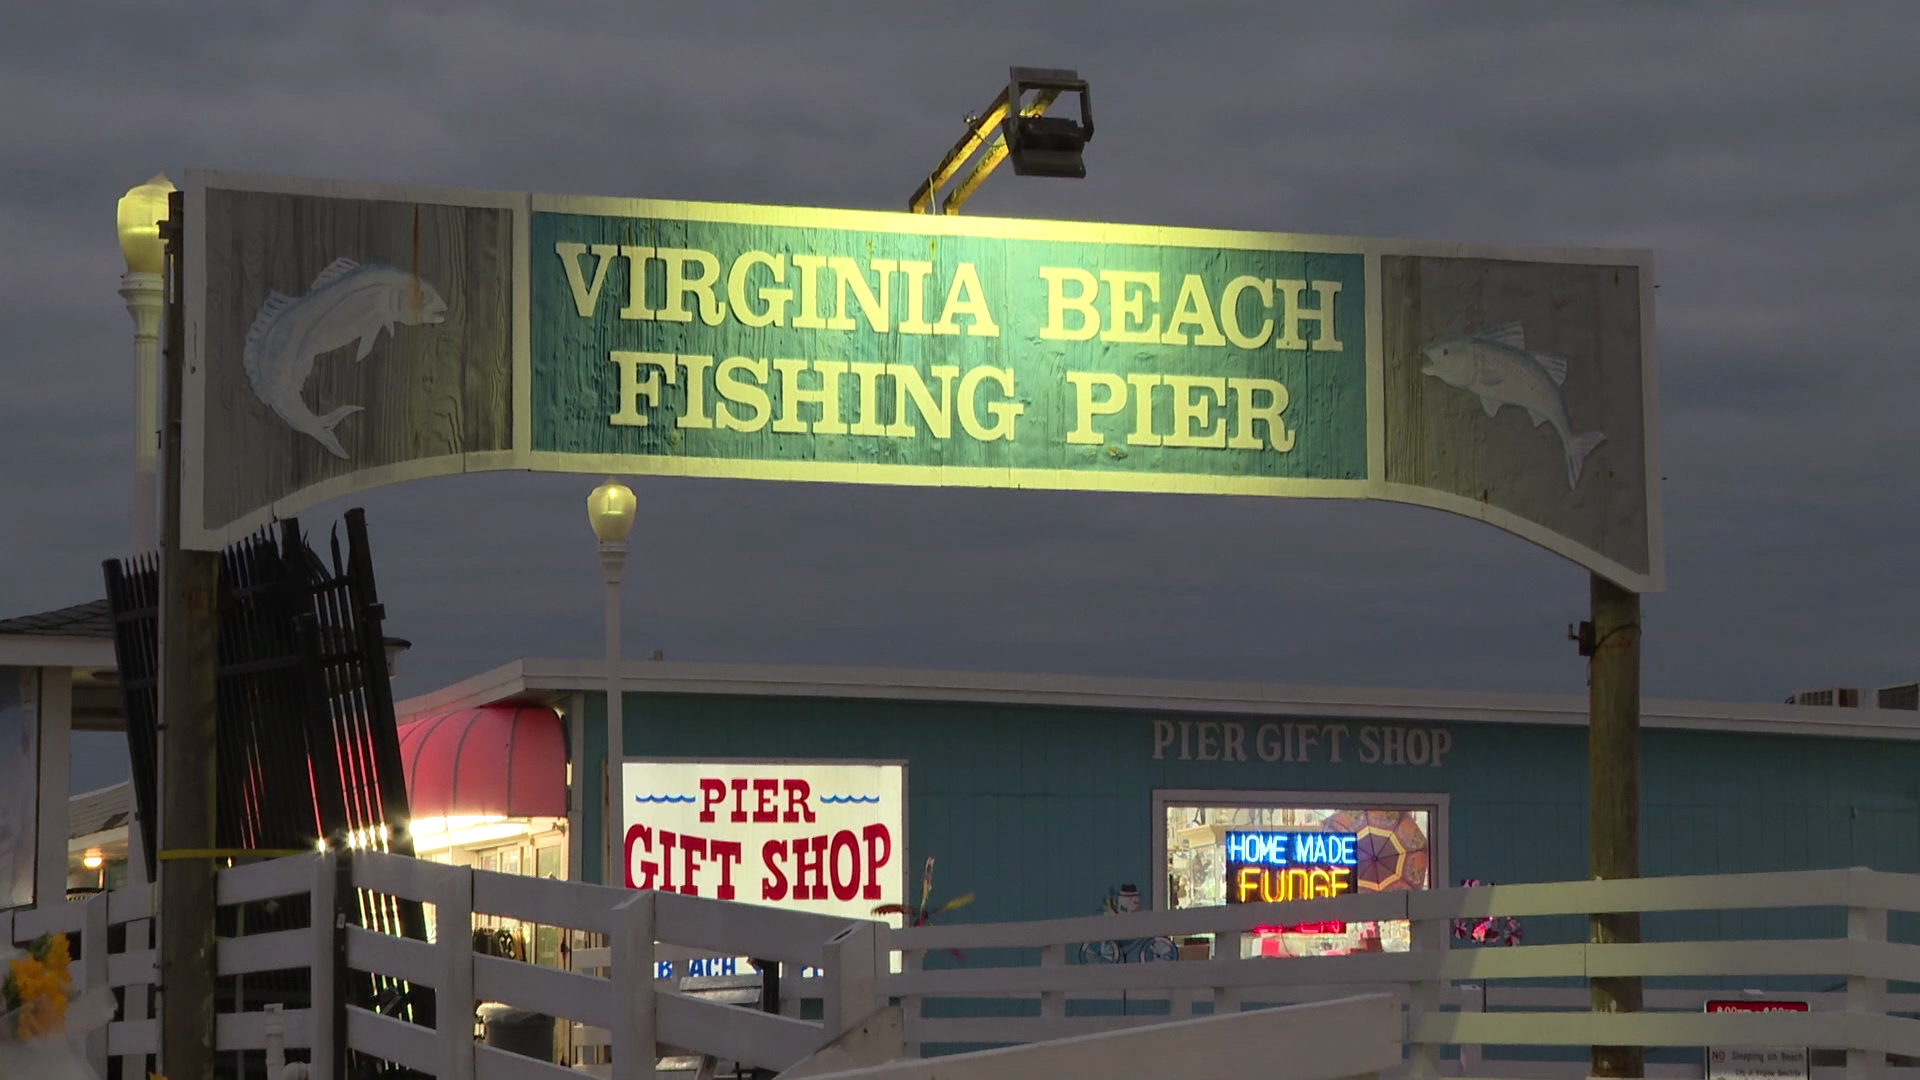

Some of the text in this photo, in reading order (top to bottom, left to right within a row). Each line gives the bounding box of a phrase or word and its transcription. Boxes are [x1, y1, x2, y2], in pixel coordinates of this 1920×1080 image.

[555, 241, 1343, 353] VIRGINIA BEACH
[609, 350, 1297, 454] FISHING PIER
[1152, 720, 1453, 767] PIER GIFT SHOP
[699, 778, 816, 823] PIER
[623, 822, 892, 902] GIFT SHOP
[1229, 834, 1357, 865] HOME MADE
[1239, 867, 1351, 903] FUDGE
[658, 957, 736, 979] BACH
[1711, 1051, 1726, 1061] NO
[1781, 1051, 1804, 1062] Beach
